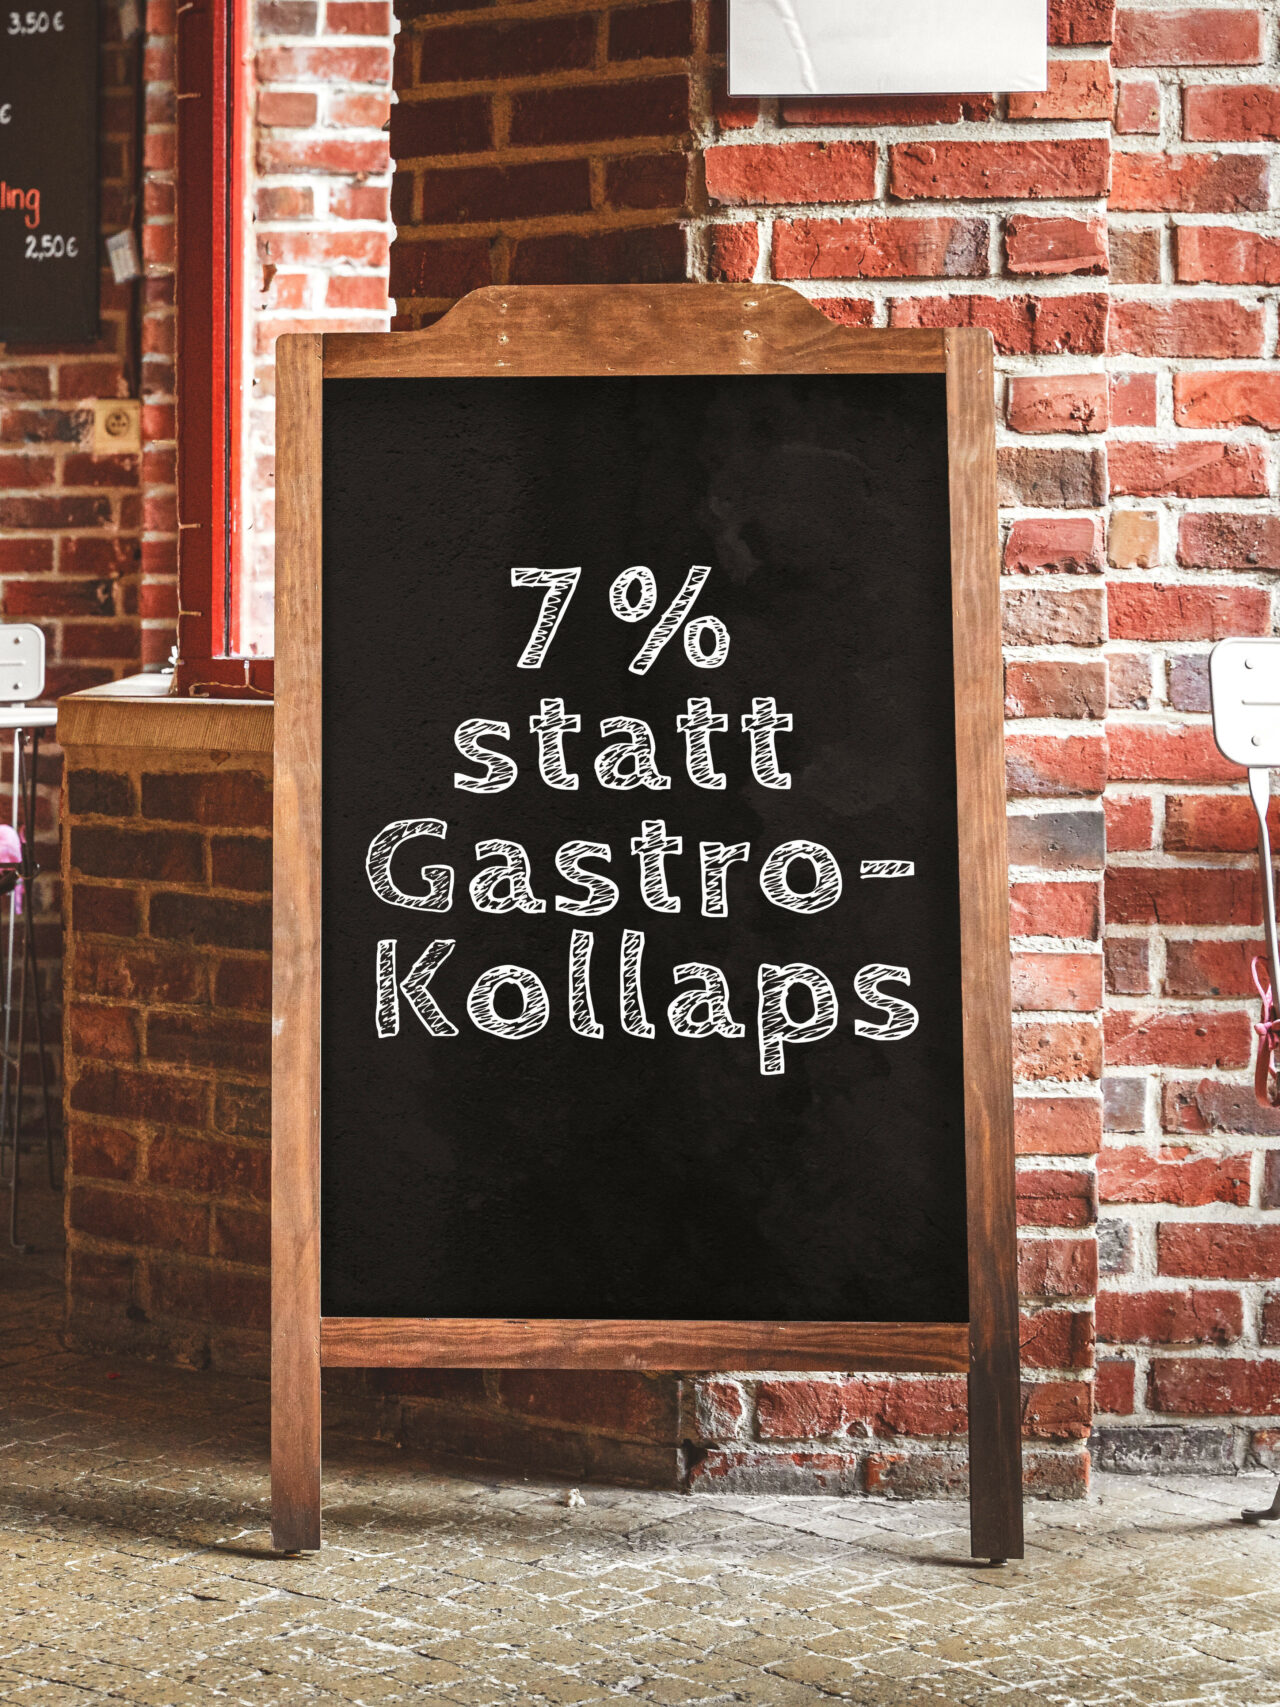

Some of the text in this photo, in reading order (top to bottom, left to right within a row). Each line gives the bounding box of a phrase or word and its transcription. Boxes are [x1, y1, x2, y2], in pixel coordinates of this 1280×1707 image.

[510, 564, 731, 676] 7 %
[453, 696, 794, 794] statt
[364, 816, 916, 918] Gastro-
[374, 928, 920, 1076] Kollaps
